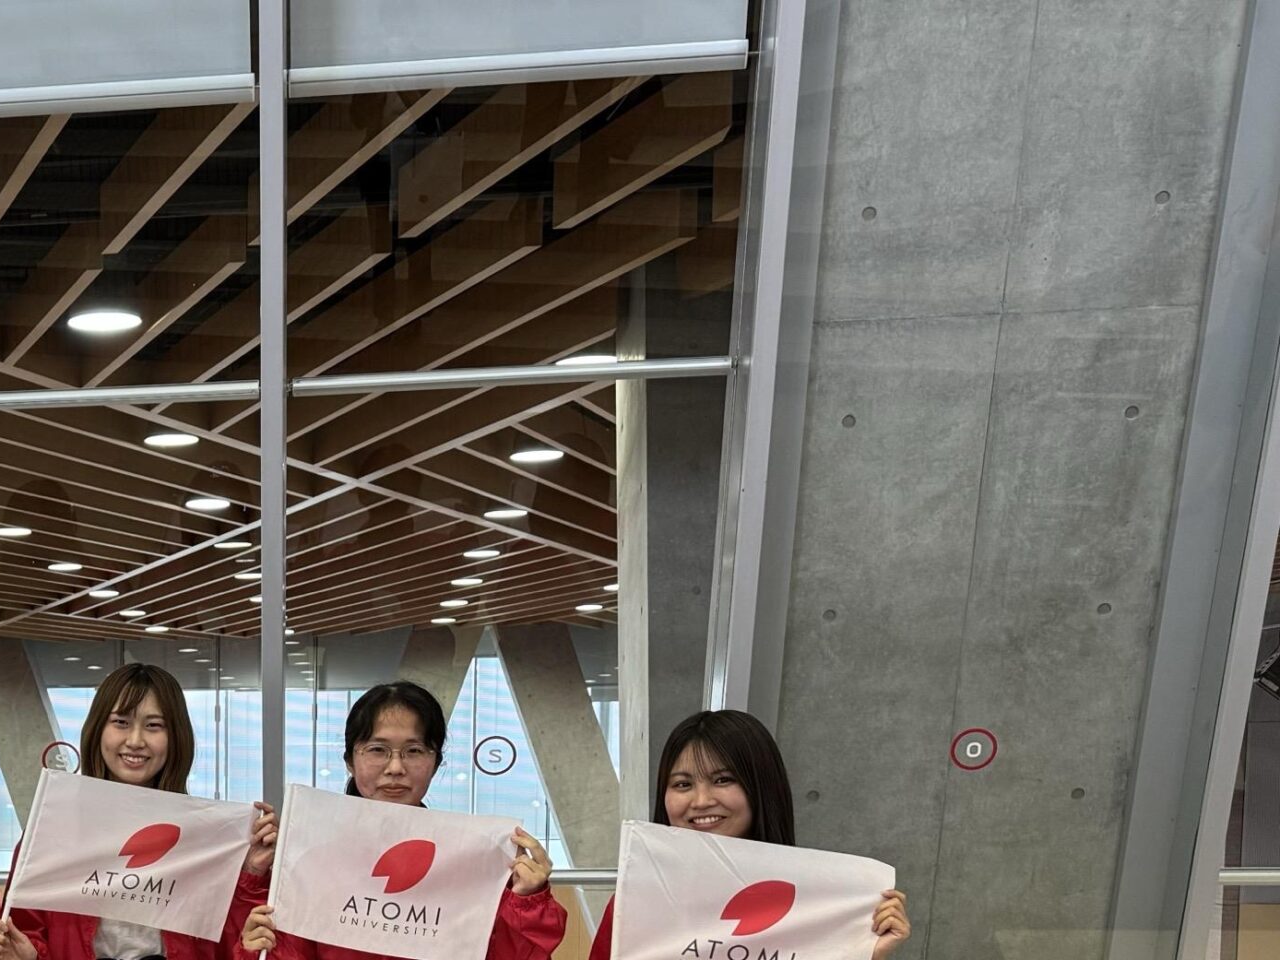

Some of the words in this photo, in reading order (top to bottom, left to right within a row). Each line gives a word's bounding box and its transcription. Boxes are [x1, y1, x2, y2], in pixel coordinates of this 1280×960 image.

[488, 749, 502, 763] S
[84, 869, 176, 896] ATOMI
[81, 887, 171, 907] UNIVERSITY
[342, 895, 441, 926] ATOMI
[339, 915, 438, 937] UNIVERSITY
